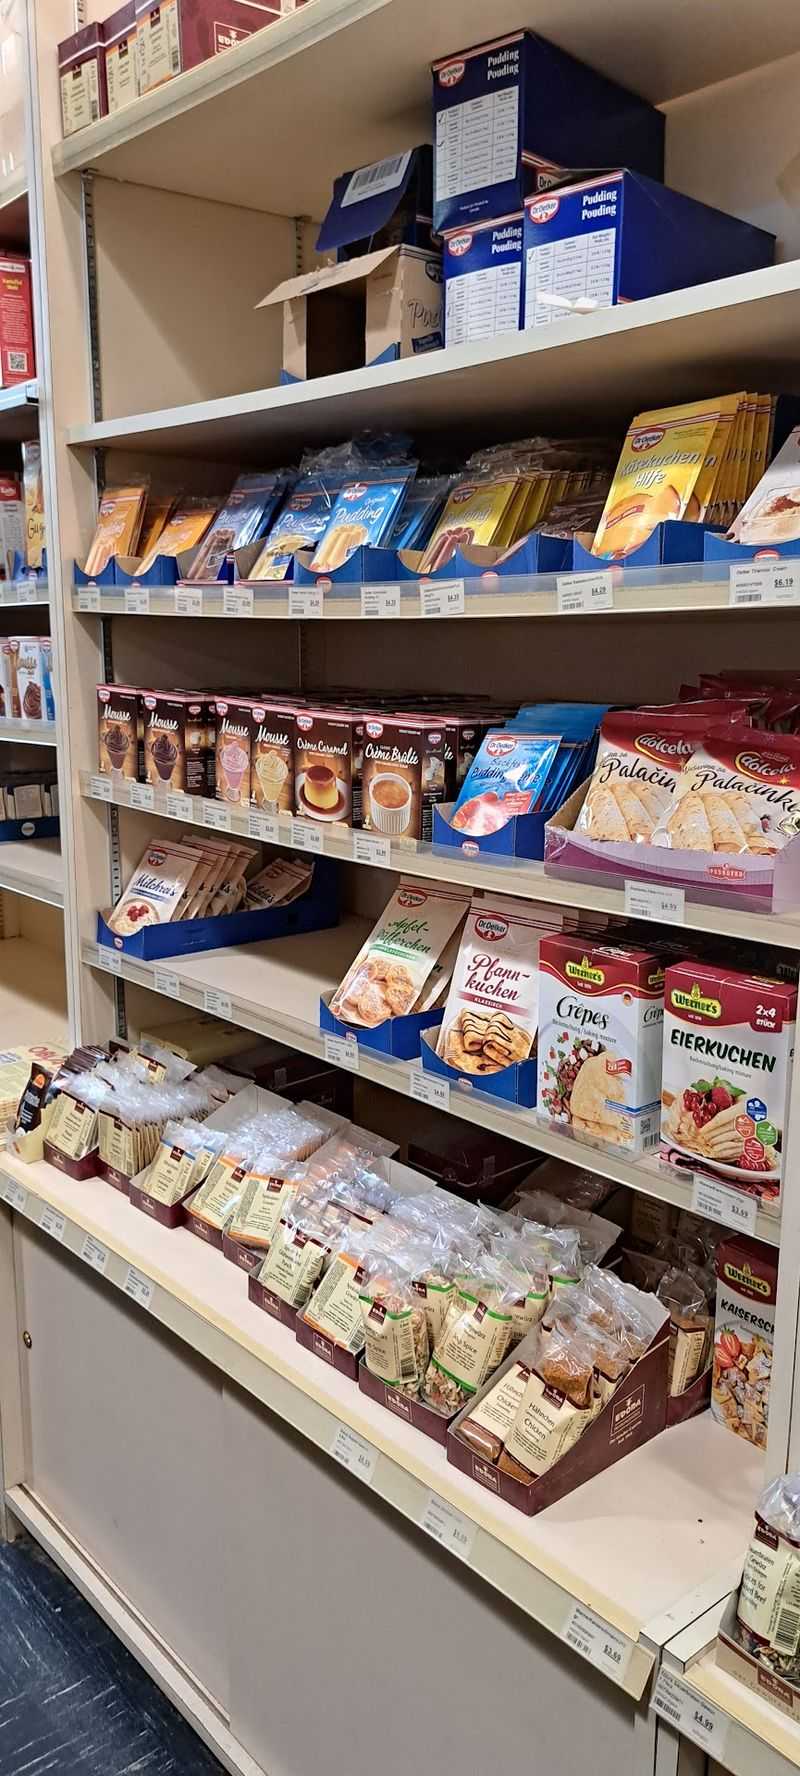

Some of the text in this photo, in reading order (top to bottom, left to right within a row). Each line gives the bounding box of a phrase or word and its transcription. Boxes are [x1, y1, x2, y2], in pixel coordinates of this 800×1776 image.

[487, 50, 519, 67] Pudding
[487, 63, 519, 80] Pouding
[583, 190, 617, 206] Pudding
[581, 203, 617, 220] Pouding
[492, 226, 522, 241] Pudding
[491, 239, 522, 255] Pouding
[635, 468, 667, 489] Hilfe
[335, 504, 385, 525] Pudding
[774, 578, 794, 588] $6.19
[102, 704, 132, 721] Mousse
[149, 712, 179, 730] Mousse
[220, 718, 249, 737] Mousse
[256, 725, 289, 745] Mousse
[297, 737, 348, 756] Crème Caramel
[365, 743, 391, 760] Crème
[600, 758, 677, 793] Palačin
[467, 953, 531, 982] Pfann-
[568, 963, 602, 982] Werner's
[465, 971, 520, 1001] kuchen
[673, 991, 718, 1015] Werner's
[755, 1004, 777, 1019] 2x4
[556, 995, 610, 1031] Crêpes
[755, 1017, 776, 1029] STÜCK
[670, 1028, 777, 1073] EIERKUCHEN
[726, 1264, 768, 1294] Werner's
[528, 1401, 555, 1428] Hähnchen
[524, 1417, 546, 1440] Chicken
[694, 1711, 714, 1731] $4.99
